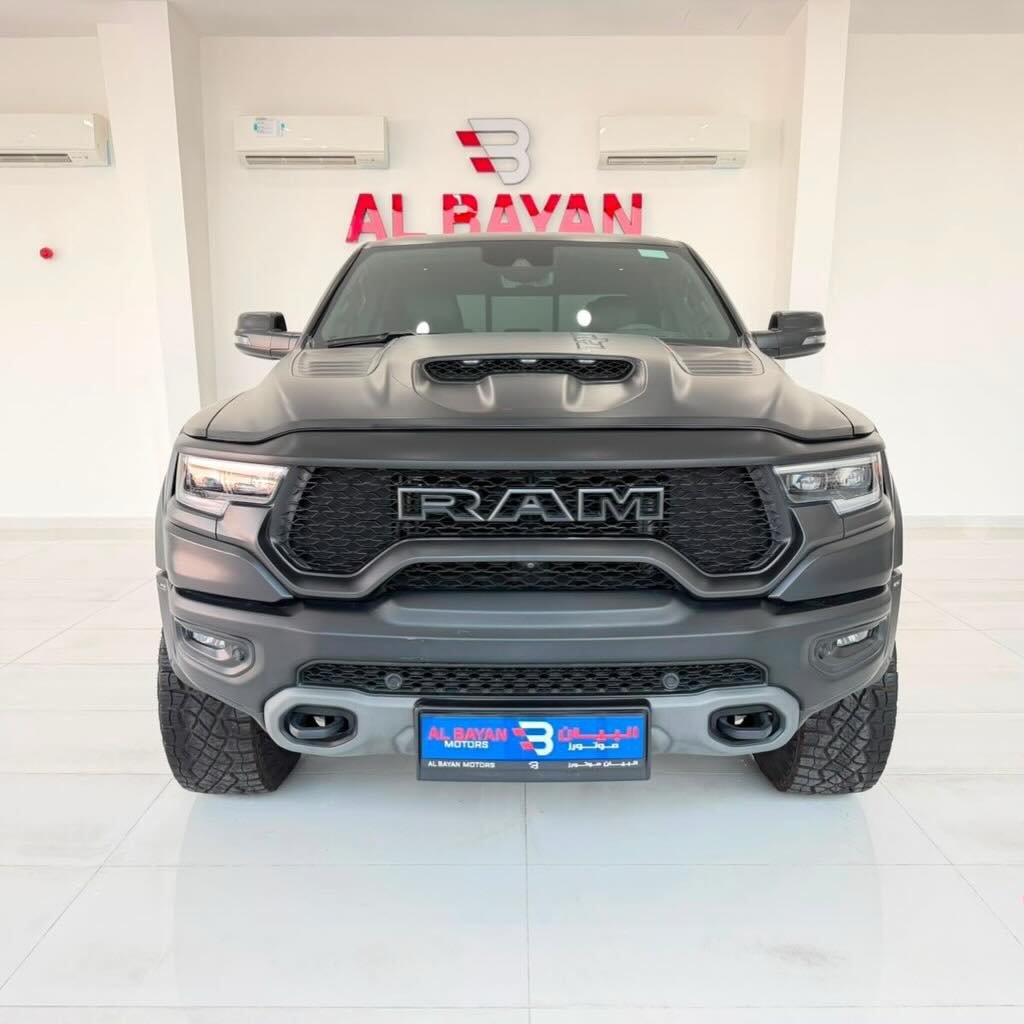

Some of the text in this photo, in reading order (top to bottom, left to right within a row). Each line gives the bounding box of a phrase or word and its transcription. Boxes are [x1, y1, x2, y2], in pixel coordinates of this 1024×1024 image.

[346, 193, 644, 243] AL BAYAN
[398, 487, 664, 522] RAM
[428, 727, 507, 742] AL BAYAN
[444, 740, 489, 749] MOTORS
